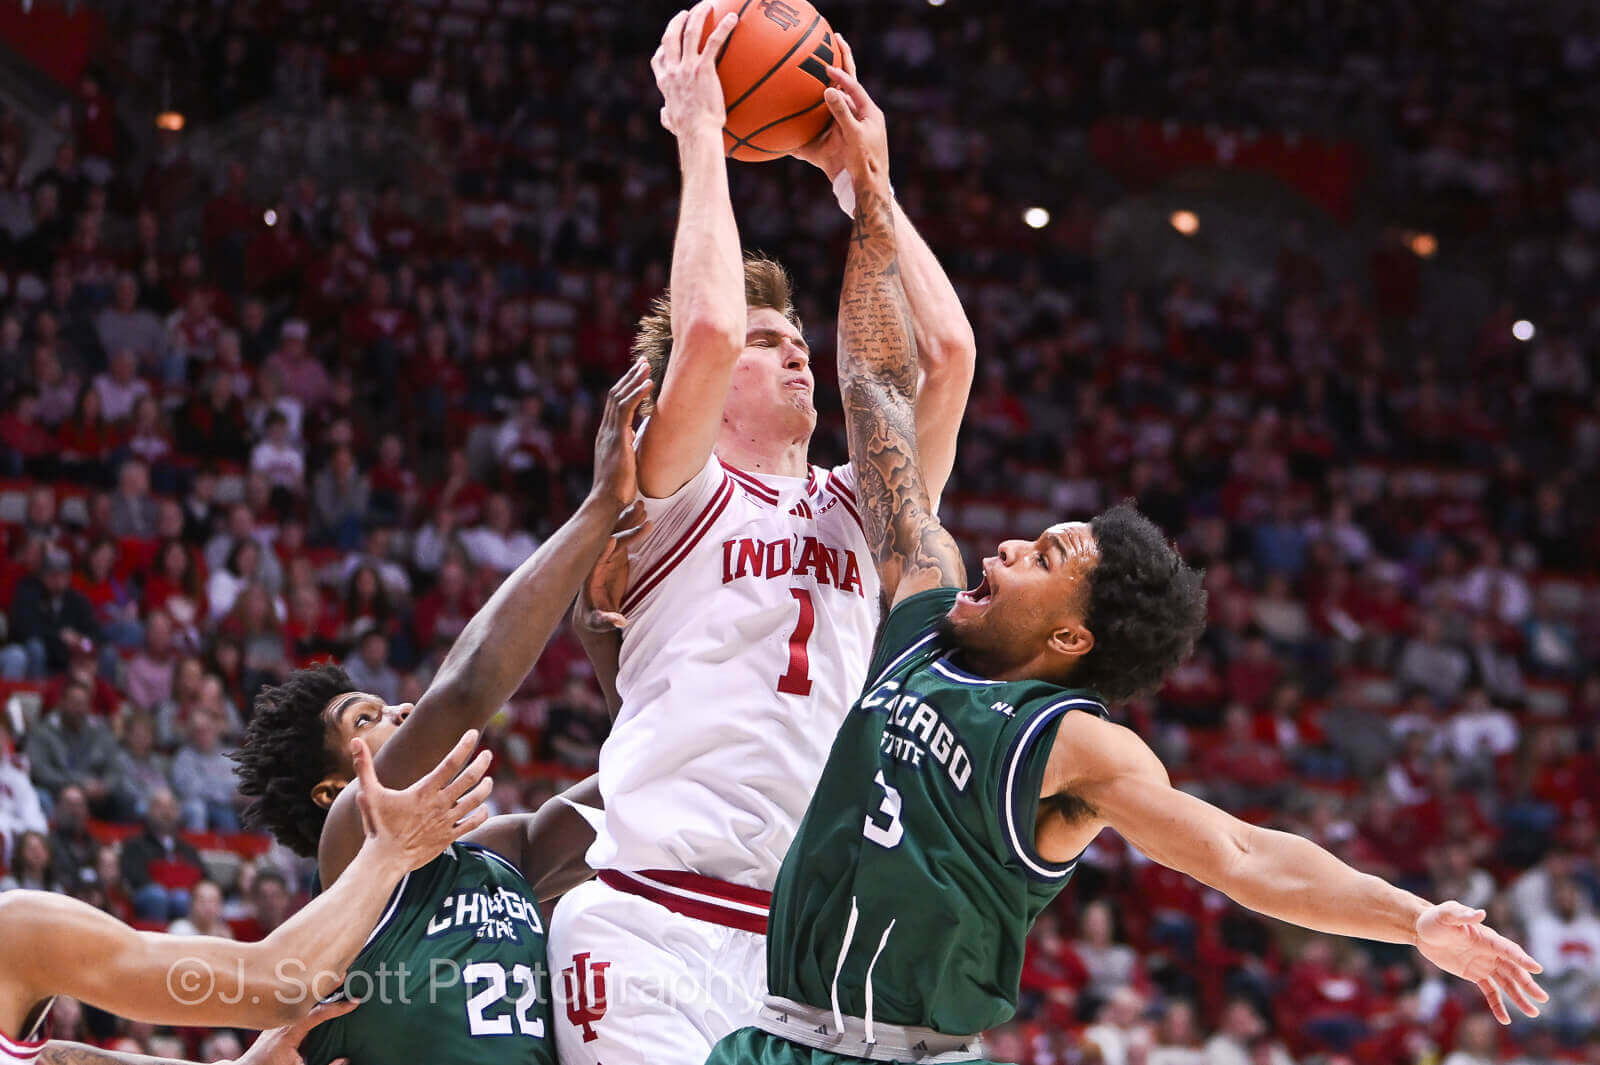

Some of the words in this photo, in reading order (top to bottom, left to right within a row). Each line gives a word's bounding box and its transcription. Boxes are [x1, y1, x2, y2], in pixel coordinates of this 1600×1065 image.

[722, 534, 865, 599] INDANA
[777, 587, 813, 696] 1
[863, 769, 904, 848] 3
[462, 962, 544, 1038] 22
